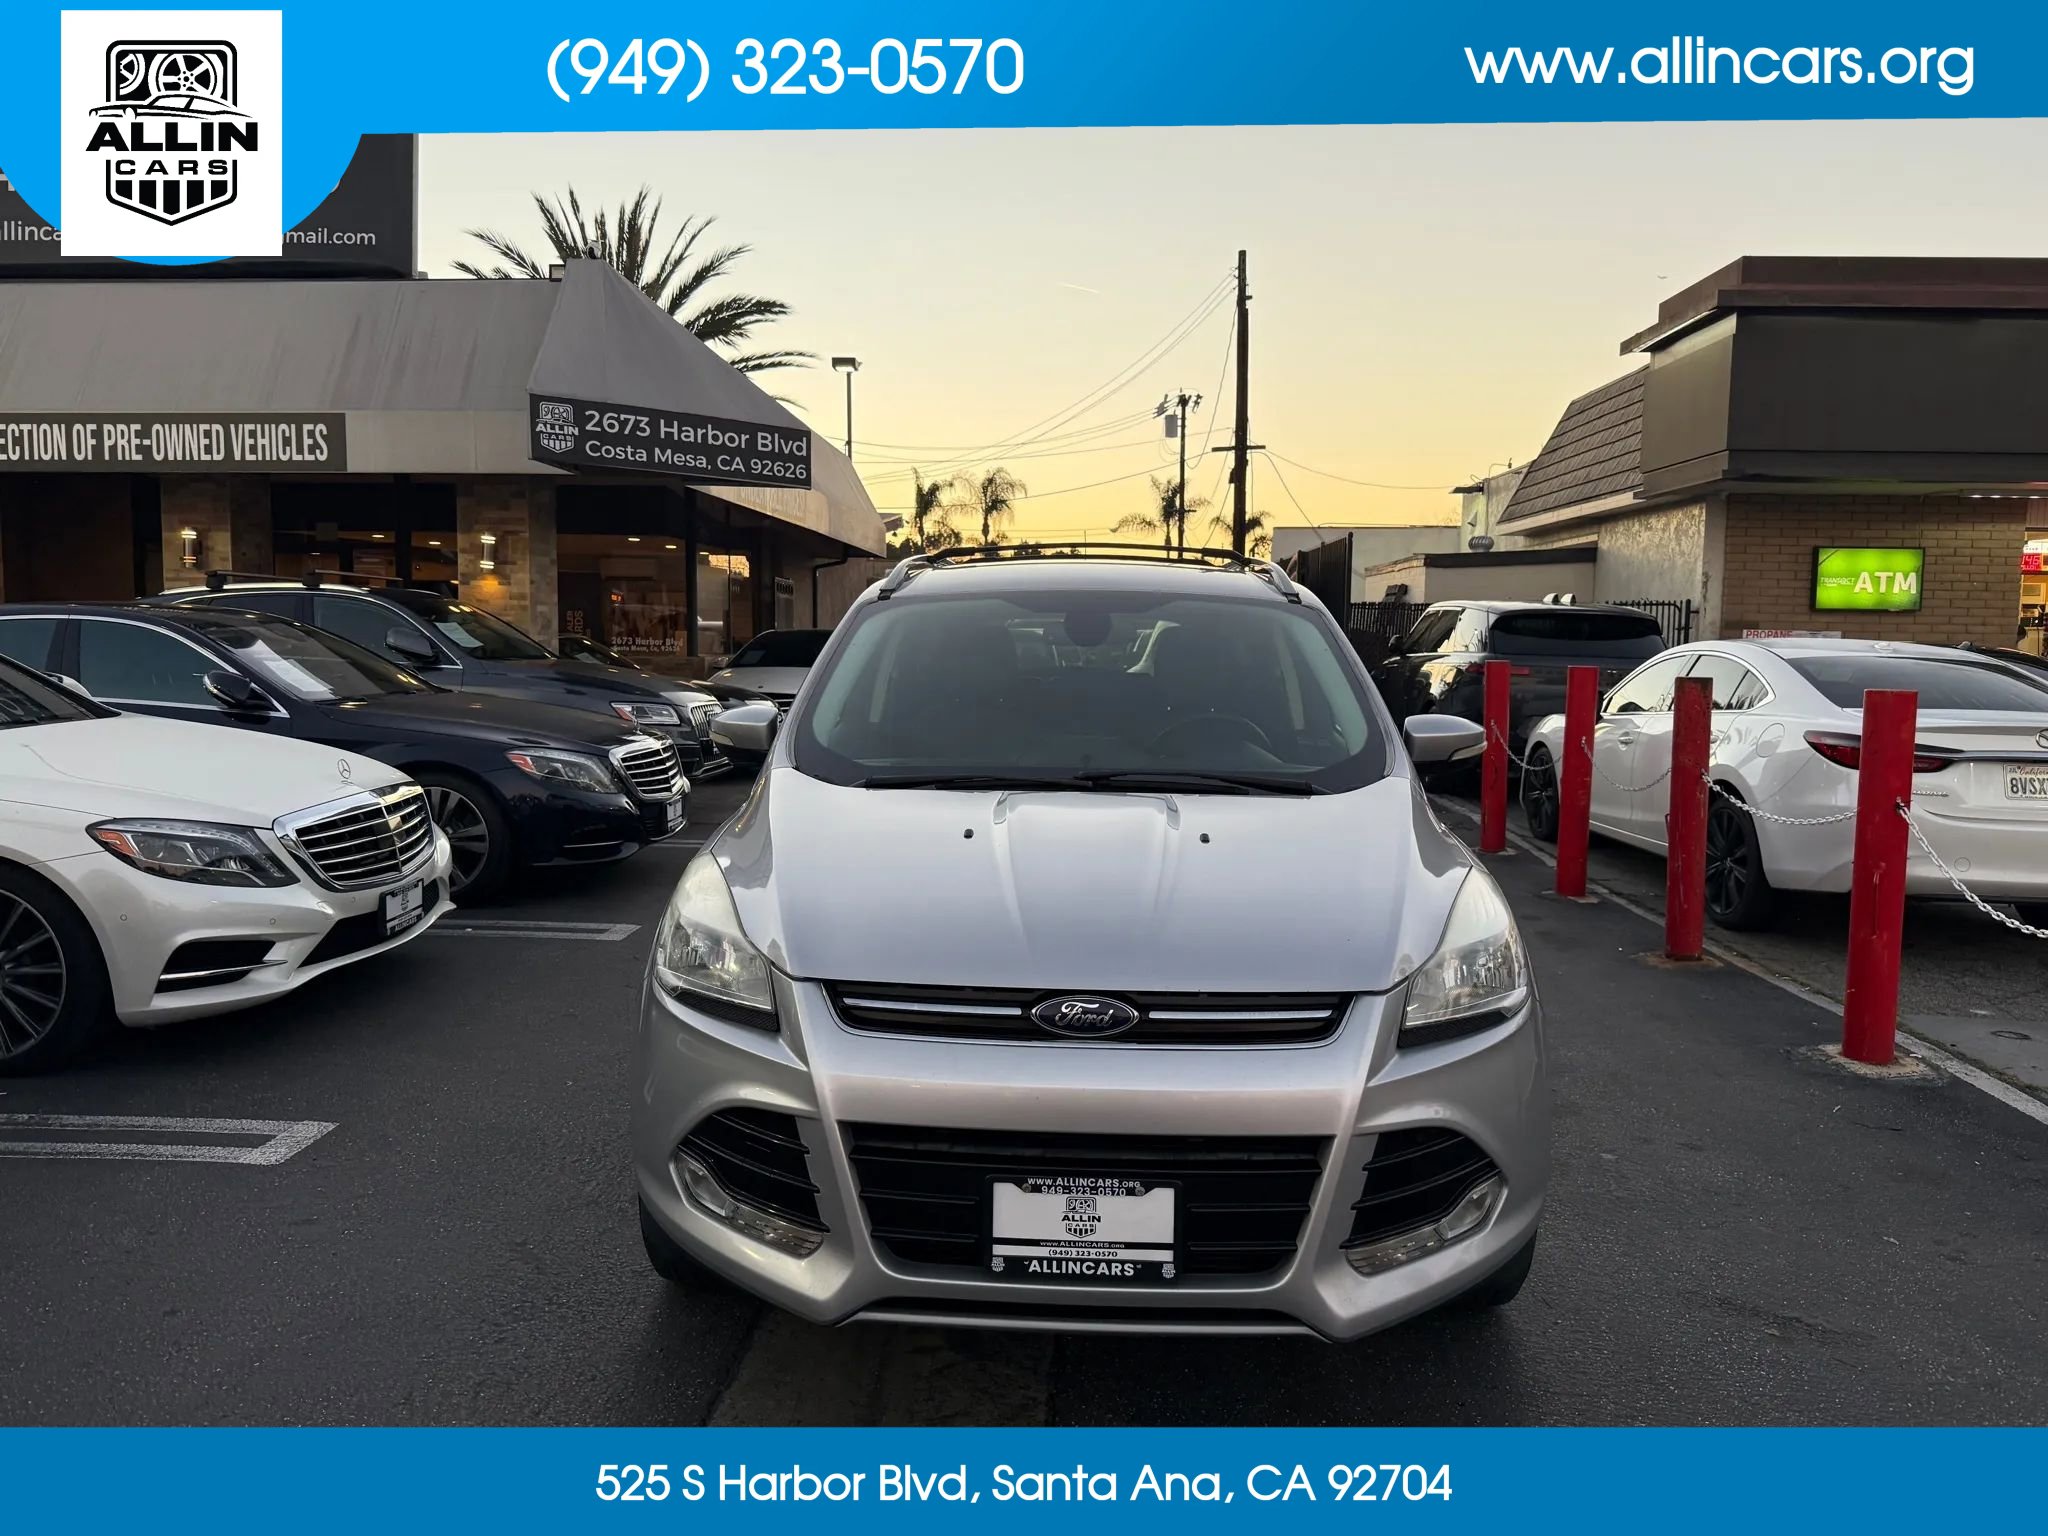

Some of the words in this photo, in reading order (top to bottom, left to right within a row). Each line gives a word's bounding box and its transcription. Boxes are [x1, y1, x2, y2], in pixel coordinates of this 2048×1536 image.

[282, 227, 376, 245] mail.com
[536, 423, 579, 435] ALLIN
[585, 410, 650, 437] 2673
[660, 419, 749, 448] Harbor
[757, 431, 806, 456] Blvd
[72, 423, 97, 460] OF
[103, 423, 225, 460] PRE-OWNED
[230, 423, 328, 460] VEHICLES
[585, 440, 647, 461] Costa
[654, 447, 711, 470] Mesa,
[717, 455, 745, 473] CA
[750, 459, 806, 479] 92626
[1854, 572, 1916, 594] ATM
[2010, 777, 2048, 795] 8VSX
[1055, 1001, 1114, 1026] Ford
[1041, 1186, 1126, 1197] 949-323-0570
[1061, 1214, 1101, 1223] ALLIN
[1048, 1249, 1073, 1257] (949)
[1028, 1259, 1135, 1276] ALLINCARS
